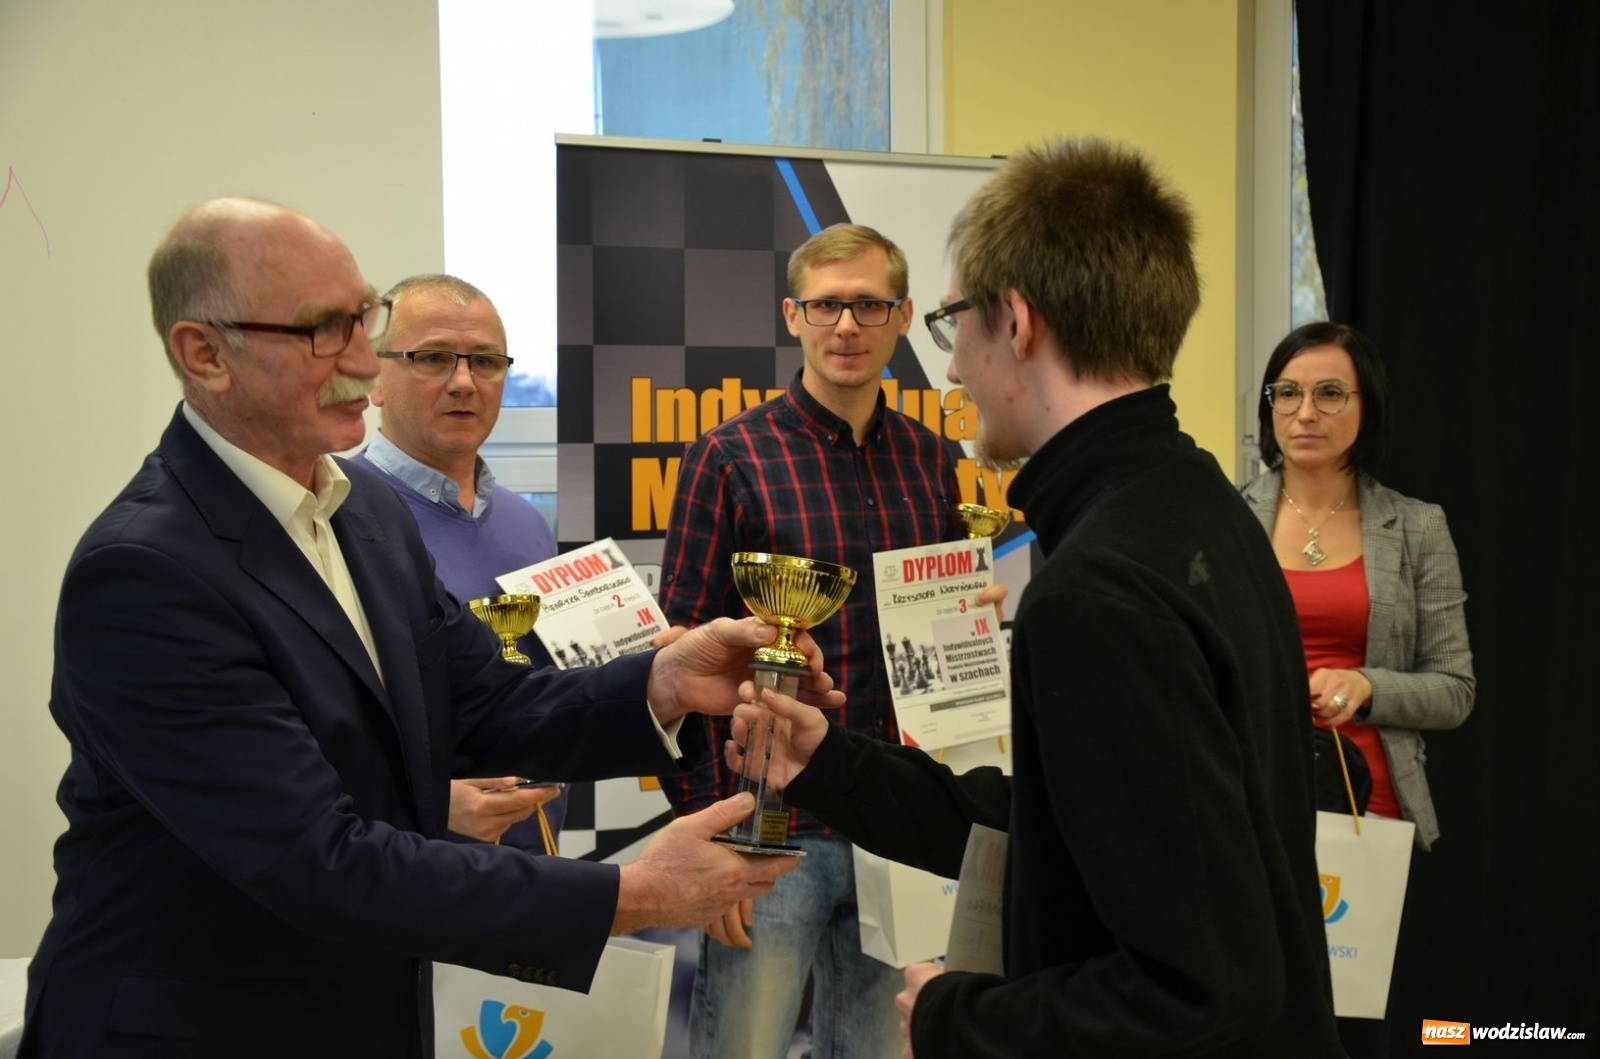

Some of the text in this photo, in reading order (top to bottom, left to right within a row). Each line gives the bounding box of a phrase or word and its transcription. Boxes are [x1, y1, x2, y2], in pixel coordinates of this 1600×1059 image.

[530, 553, 610, 595] DYPLOM
[902, 550, 973, 584] DYPLOM
[612, 594, 625, 609] 2
[958, 598, 967, 614] 3
[637, 607, 656, 626] IX
[974, 618, 990, 636] IX
[942, 636, 994, 652] Indywidualnych
[945, 646, 997, 663] Mistrzostwach
[950, 664, 1001, 683] w szachach
